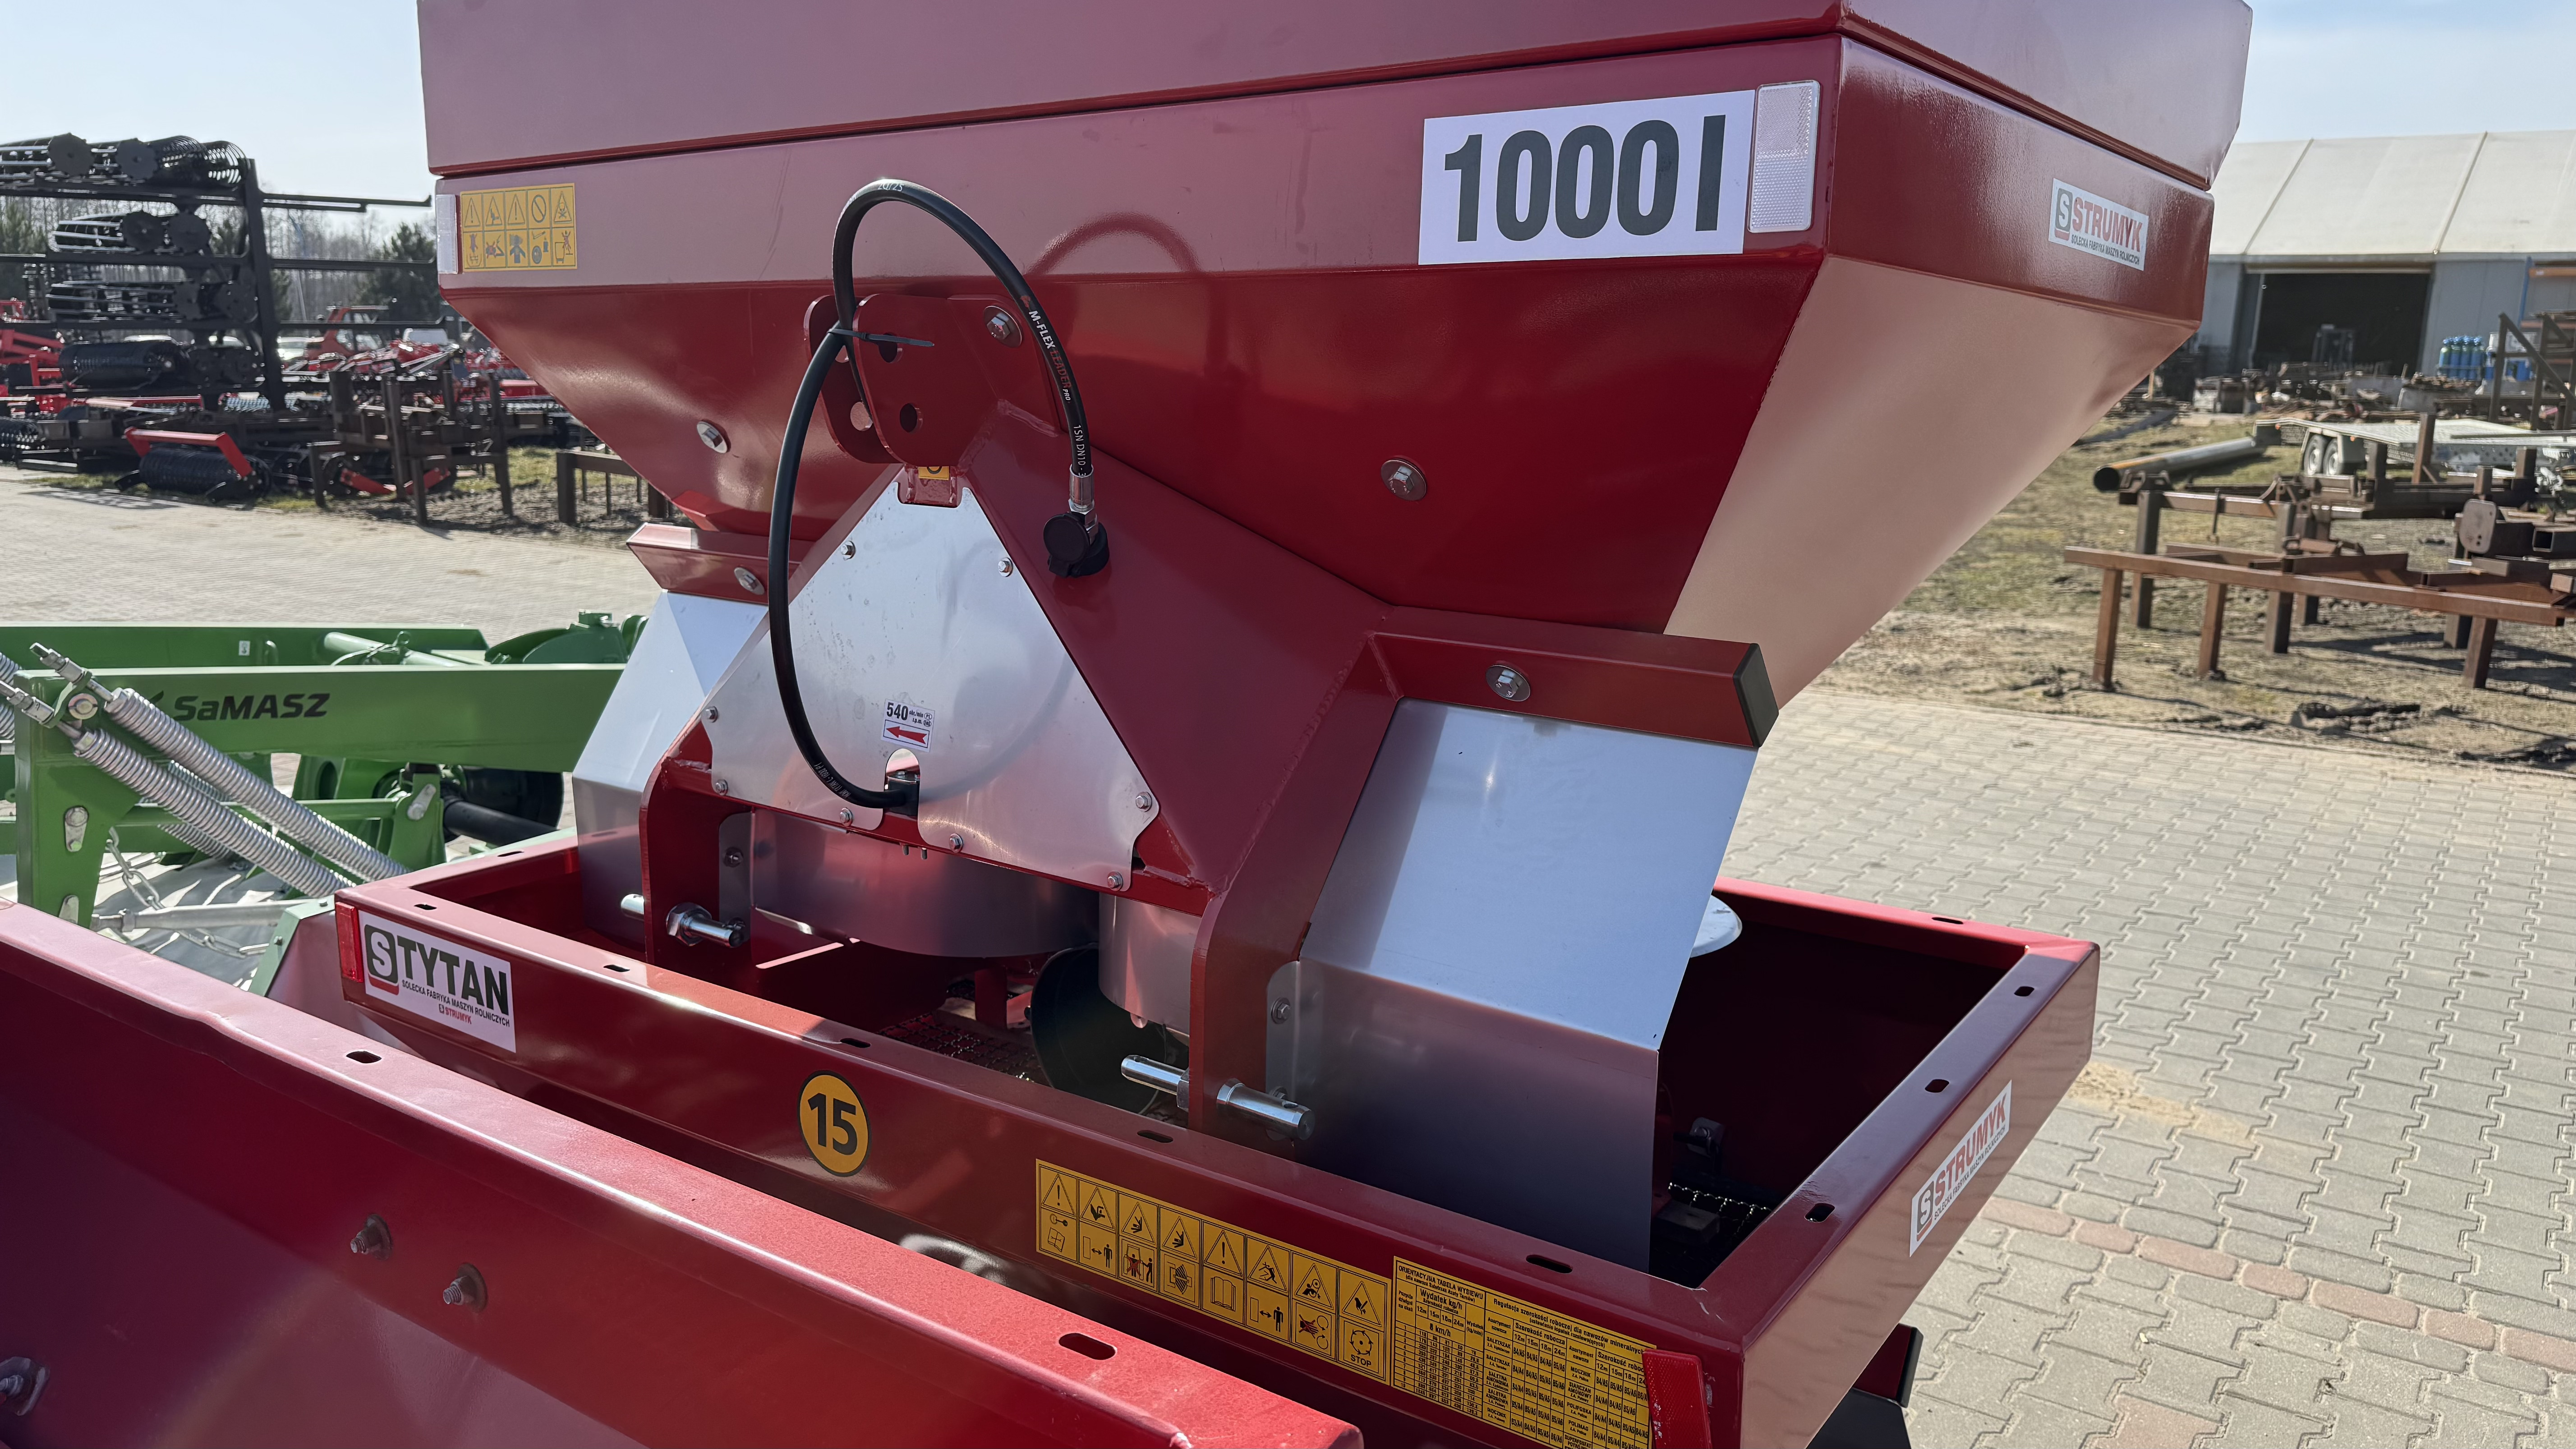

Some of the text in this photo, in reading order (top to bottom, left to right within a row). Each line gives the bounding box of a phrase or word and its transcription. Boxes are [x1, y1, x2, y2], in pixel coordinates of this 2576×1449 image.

[1445, 120, 1679, 242] 1000
[2072, 197, 2143, 252] STRUMYK
[2071, 234, 2140, 265] SOLECKA FABRYKA MASZYN ROLNICZYCH
[1029, 310, 1055, 350] M-FLEX
[1063, 388, 1071, 401] PRO
[1073, 424, 1084, 441] 1SN
[1076, 444, 1086, 465] DN10
[173, 693, 330, 721] SaMASZ
[887, 702, 908, 721] 540
[402, 980, 510, 1027] SOLECKA FABRYKA MASZYN ROLNICZYCH
[445, 1007, 472, 1025] STRUMYK
[808, 1093, 857, 1155] 15
[1934, 1094, 2006, 1206] STRUMYK
[1934, 1193, 1952, 1221] SOLECKA
[1952, 1172, 1969, 1198] FABRYKA
[1420, 1288, 1462, 1310] Wydatek kg/h
[1437, 1278, 1456, 1291] TABELA
[1457, 1285, 1483, 1300] WYSIEWU
[1429, 1323, 1451, 1337] 8 km/h
[1351, 1354, 1371, 1367] STOP
[1597, 1351, 1627, 1366] Szerokość
[1596, 1363, 1608, 1372] 12m
[1611, 1368, 1623, 1377] 15m
